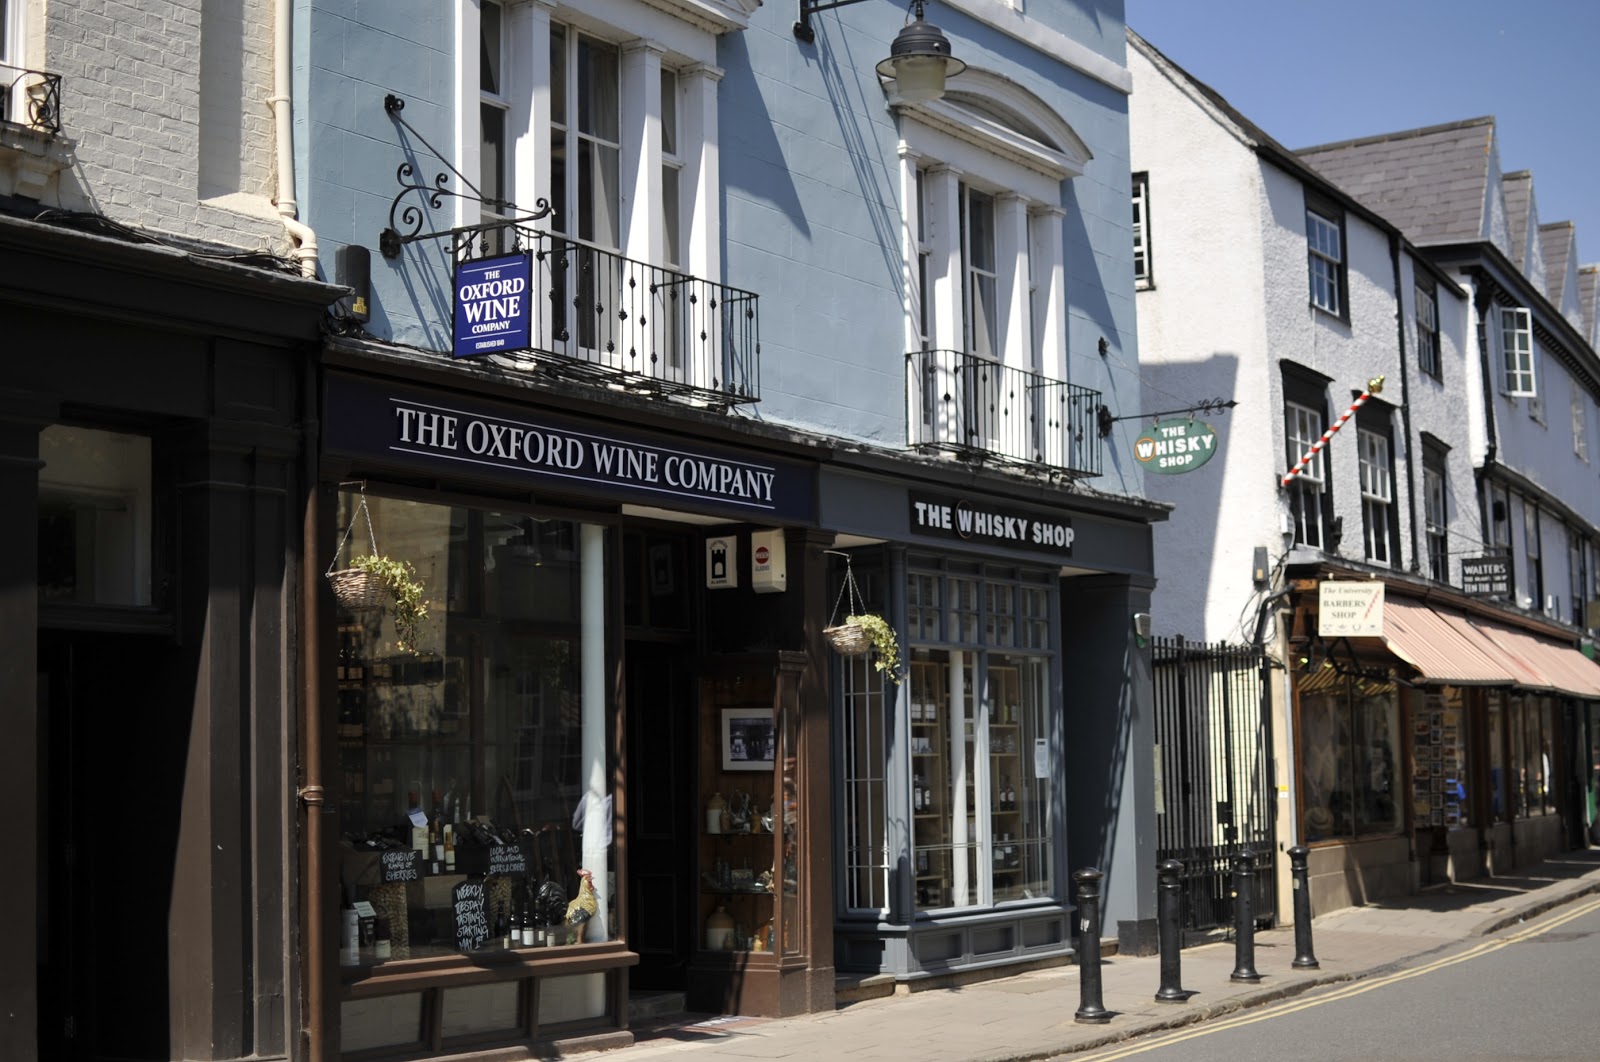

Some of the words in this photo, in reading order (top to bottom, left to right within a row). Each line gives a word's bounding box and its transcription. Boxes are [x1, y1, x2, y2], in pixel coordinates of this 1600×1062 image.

[484, 270, 500, 280] THE
[460, 277, 525, 301] OXFORD
[463, 295, 520, 323] WINE
[472, 320, 510, 334] COMPANY
[1161, 425, 1186, 438] THE
[1137, 434, 1214, 458] WHISKY
[396, 407, 458, 450] THE
[466, 420, 584, 469] OXFORD
[591, 442, 659, 483] WINE
[664, 456, 775, 501] COMPANY
[1159, 454, 1193, 468] SHOP
[914, 502, 952, 530] THE
[957, 509, 1028, 541] WHISKY
[1032, 521, 1075, 548] SHOP
[1464, 563, 1506, 575] WALTERS
[1338, 587, 1373, 595] University
[1323, 600, 1366, 608] BARBERS
[1331, 611, 1357, 619] SHOP
[382, 851, 416, 864] EXTENSIVE
[405, 861, 412, 869] OF
[385, 869, 417, 881] SHERRIES
[456, 924, 488, 939] STARTING
[459, 937, 473, 951] MAY
